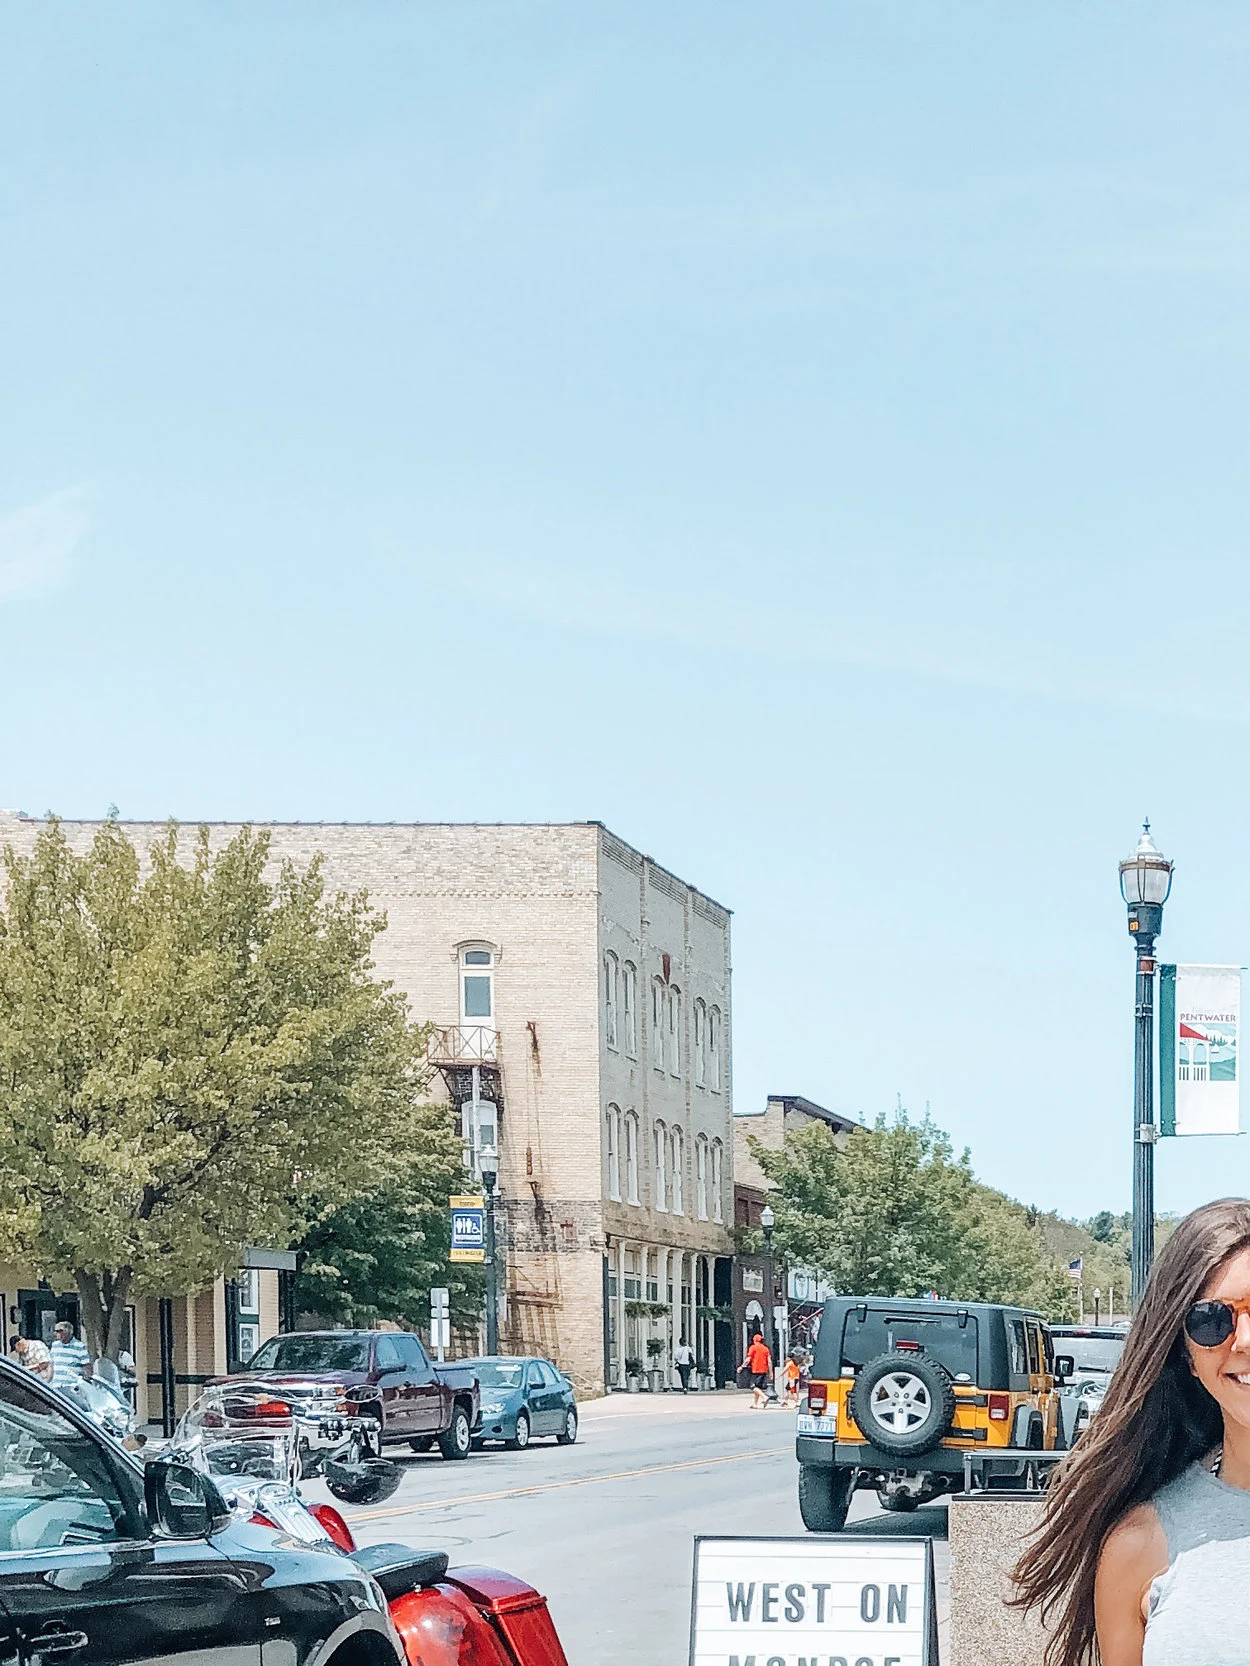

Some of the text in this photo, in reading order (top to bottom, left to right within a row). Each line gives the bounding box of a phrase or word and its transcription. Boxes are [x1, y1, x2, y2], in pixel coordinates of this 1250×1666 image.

[1179, 1013, 1237, 1022] PENTWATER
[726, 1582, 908, 1624] WEST ON
